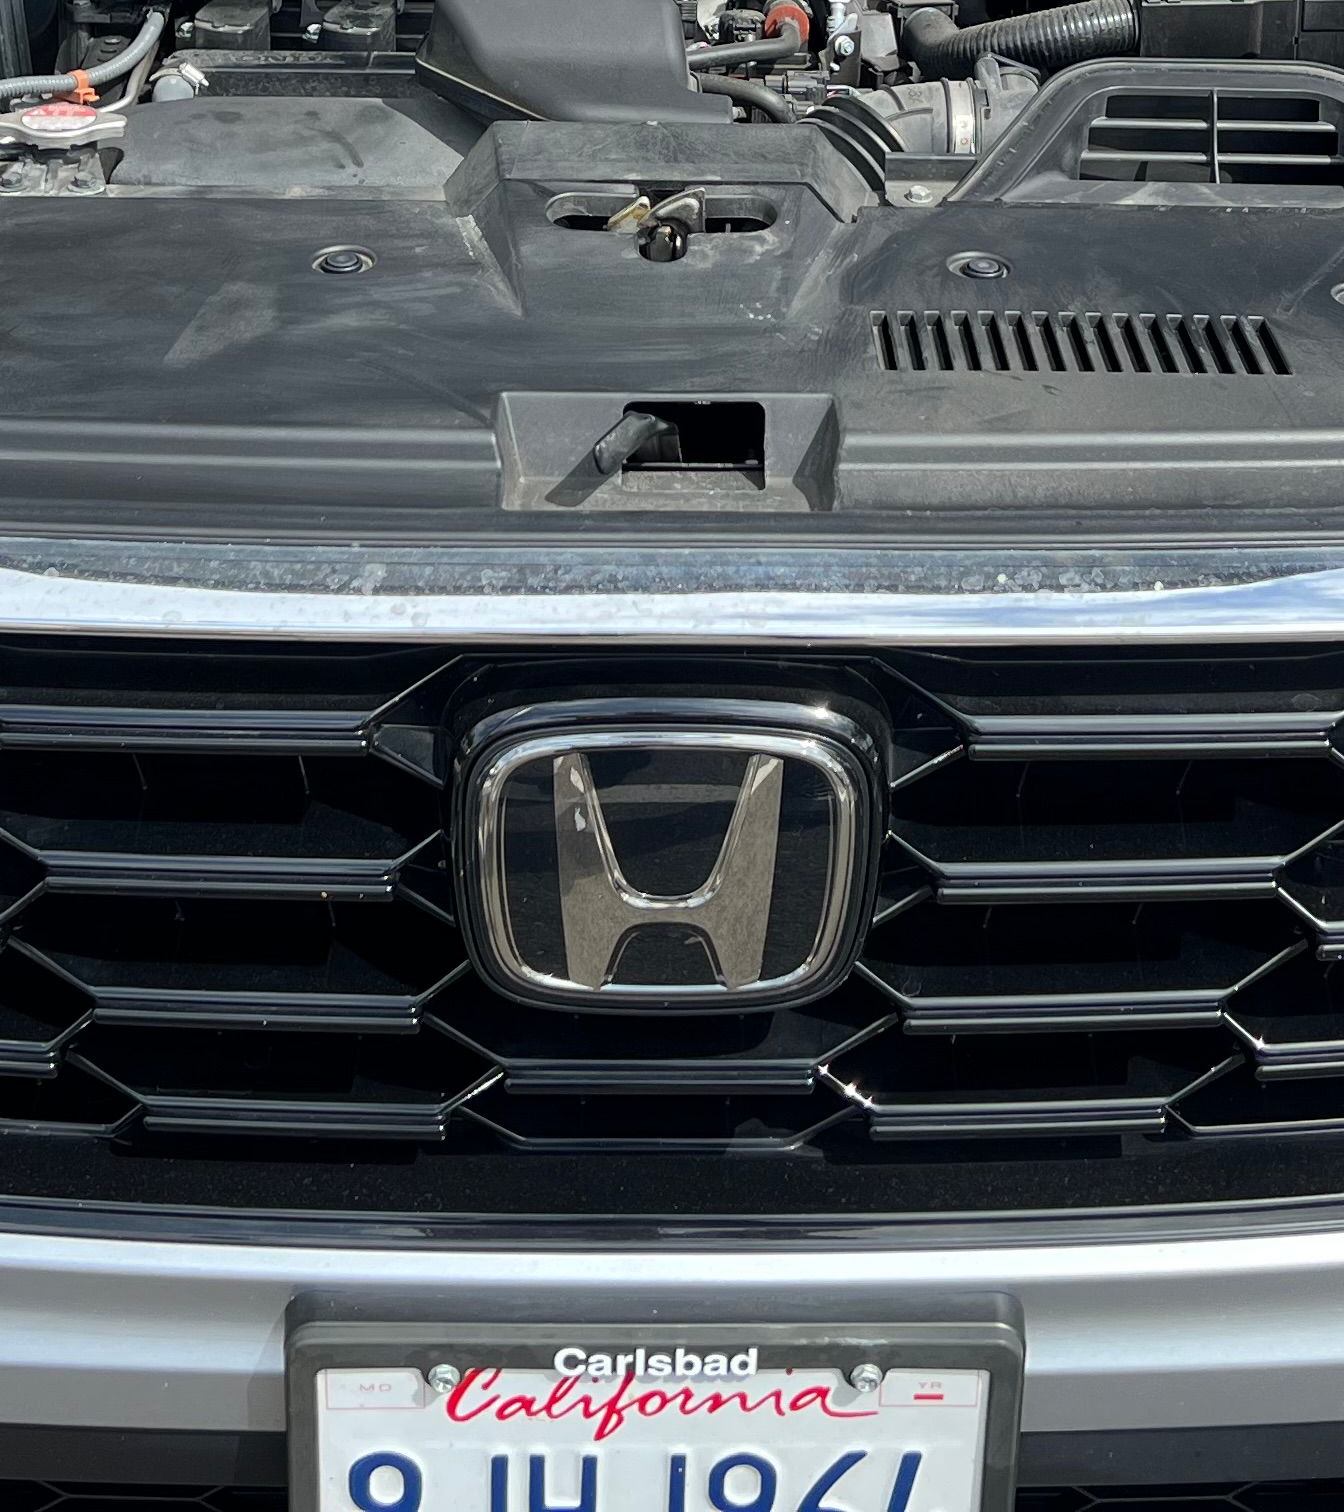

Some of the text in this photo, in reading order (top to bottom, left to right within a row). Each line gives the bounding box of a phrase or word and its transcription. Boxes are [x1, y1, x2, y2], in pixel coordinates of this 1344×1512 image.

[554, 1347, 759, 1377] Carlsbad
[359, 1383, 392, 1393] MO
[918, 1380, 943, 1390] YR
[446, 1367, 879, 1441] California
